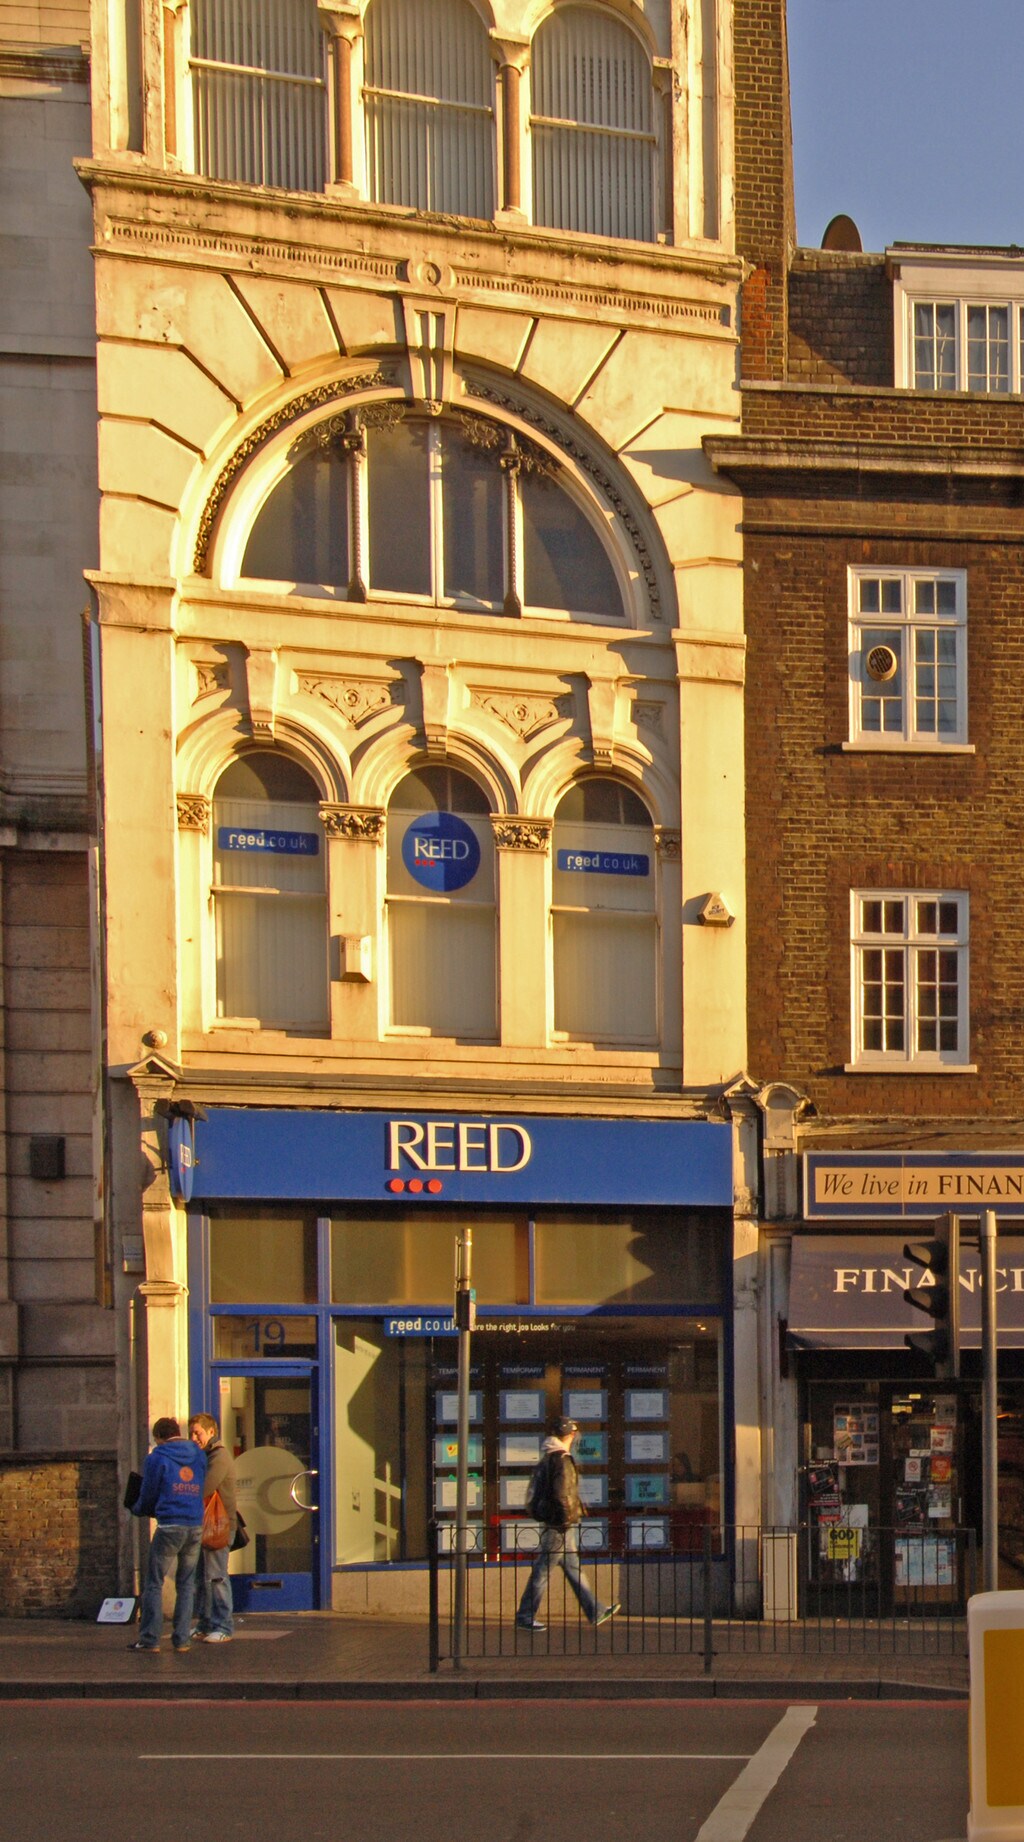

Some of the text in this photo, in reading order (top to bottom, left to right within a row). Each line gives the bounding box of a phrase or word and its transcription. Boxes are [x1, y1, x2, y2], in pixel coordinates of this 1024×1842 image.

[415, 837, 470, 859] REED
[389, 1121, 532, 1172] REED
[823, 1173, 853, 1195] We
[861, 1173, 899, 1195] live
[908, 1174, 929, 1195] in
[247, 1320, 286, 1352] 19
[499, 1323, 517, 1333] right
[502, 1366, 543, 1375] TEMPORARY
[565, 1366, 605, 1374] PERMANENT
[627, 1366, 667, 1374] PERMANENT
[830, 1529, 854, 1541] GOD
